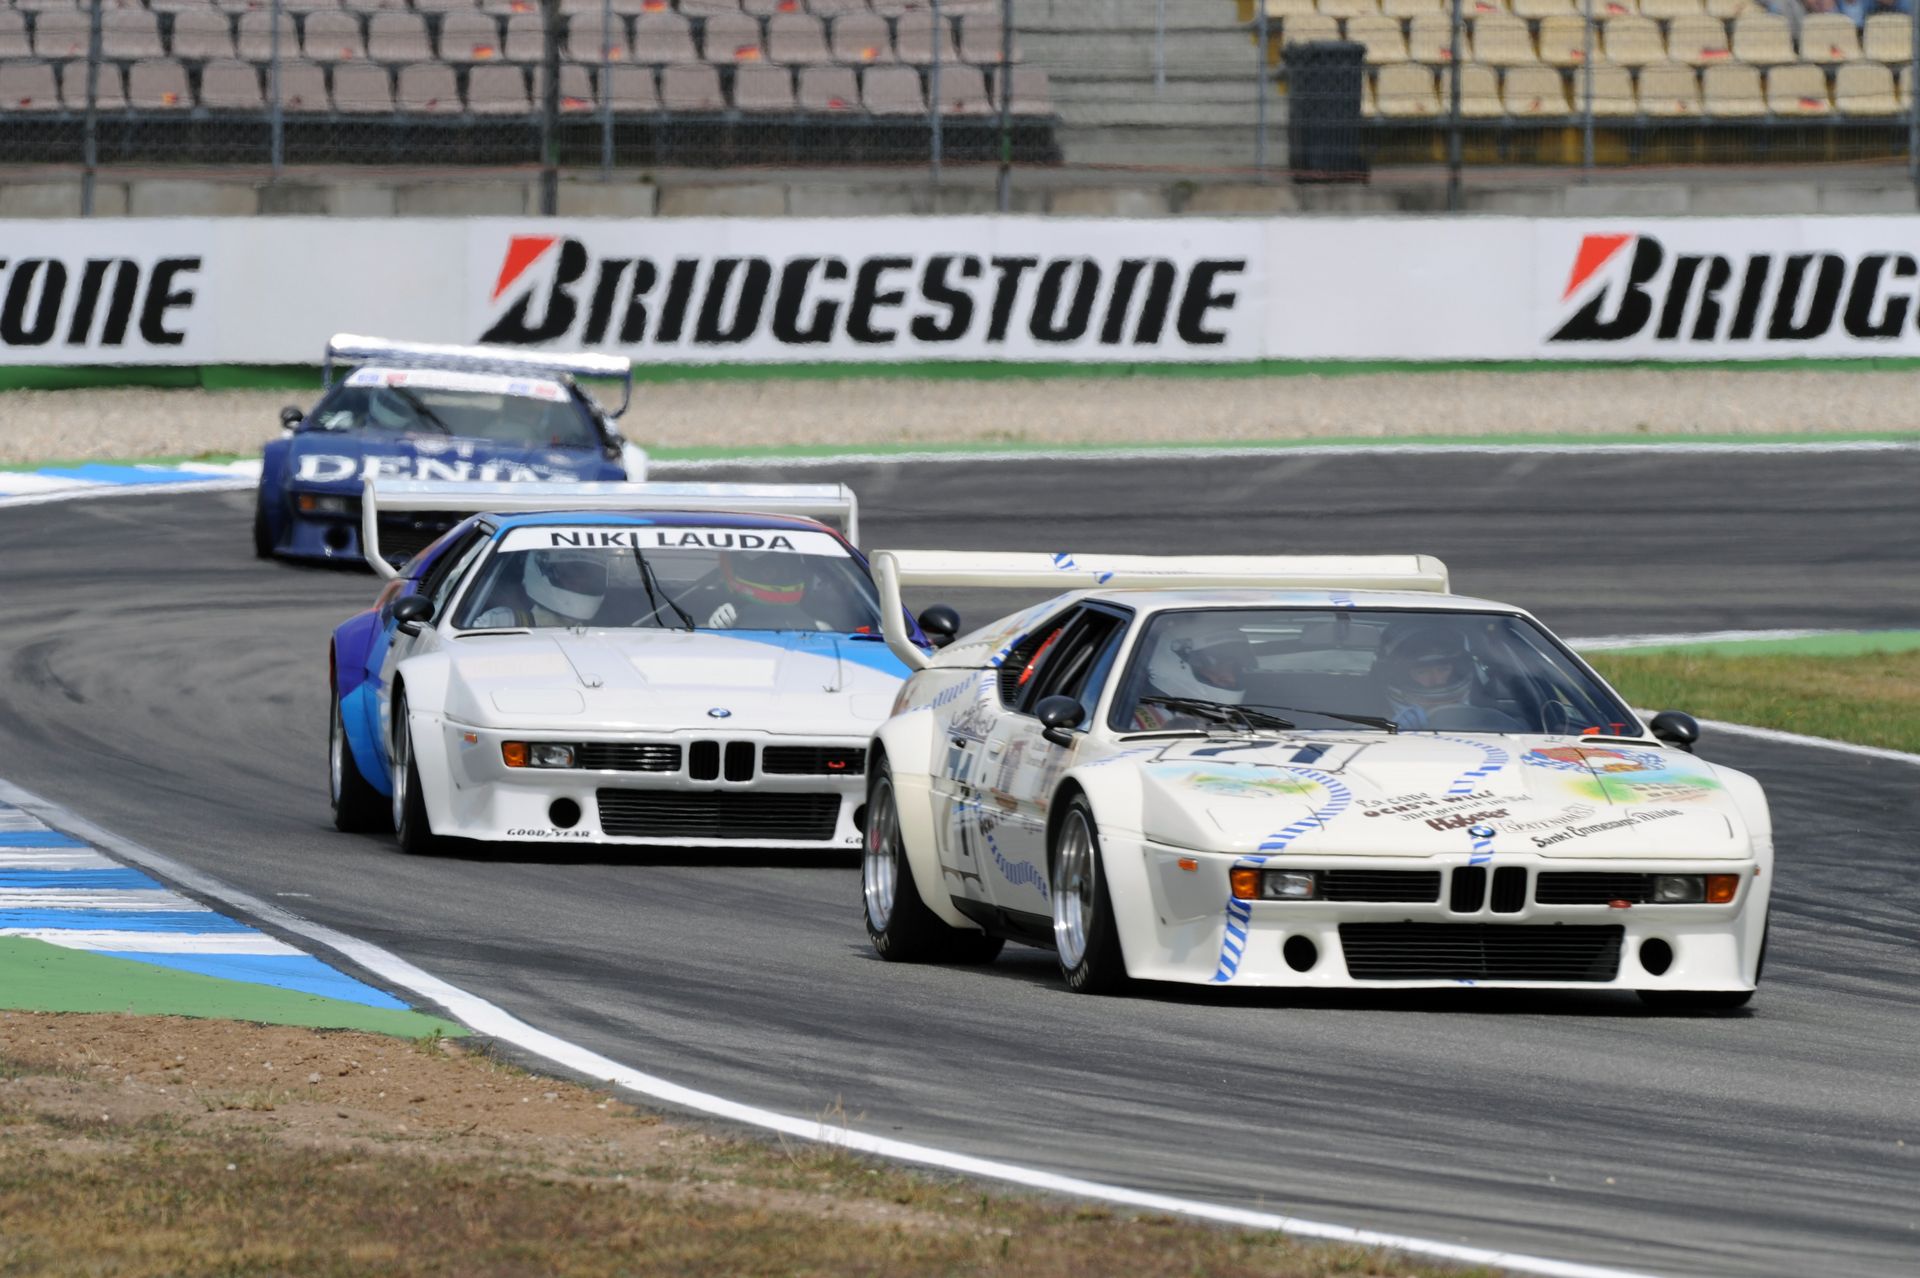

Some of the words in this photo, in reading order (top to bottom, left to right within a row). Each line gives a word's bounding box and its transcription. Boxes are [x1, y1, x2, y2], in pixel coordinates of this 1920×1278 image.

[0, 256, 200, 345] ONE
[479, 235, 1245, 344] BRIDGESTONE
[1549, 234, 1920, 340] BRIDG
[551, 532, 638, 547] NIKI
[656, 532, 796, 550] LAUDA
